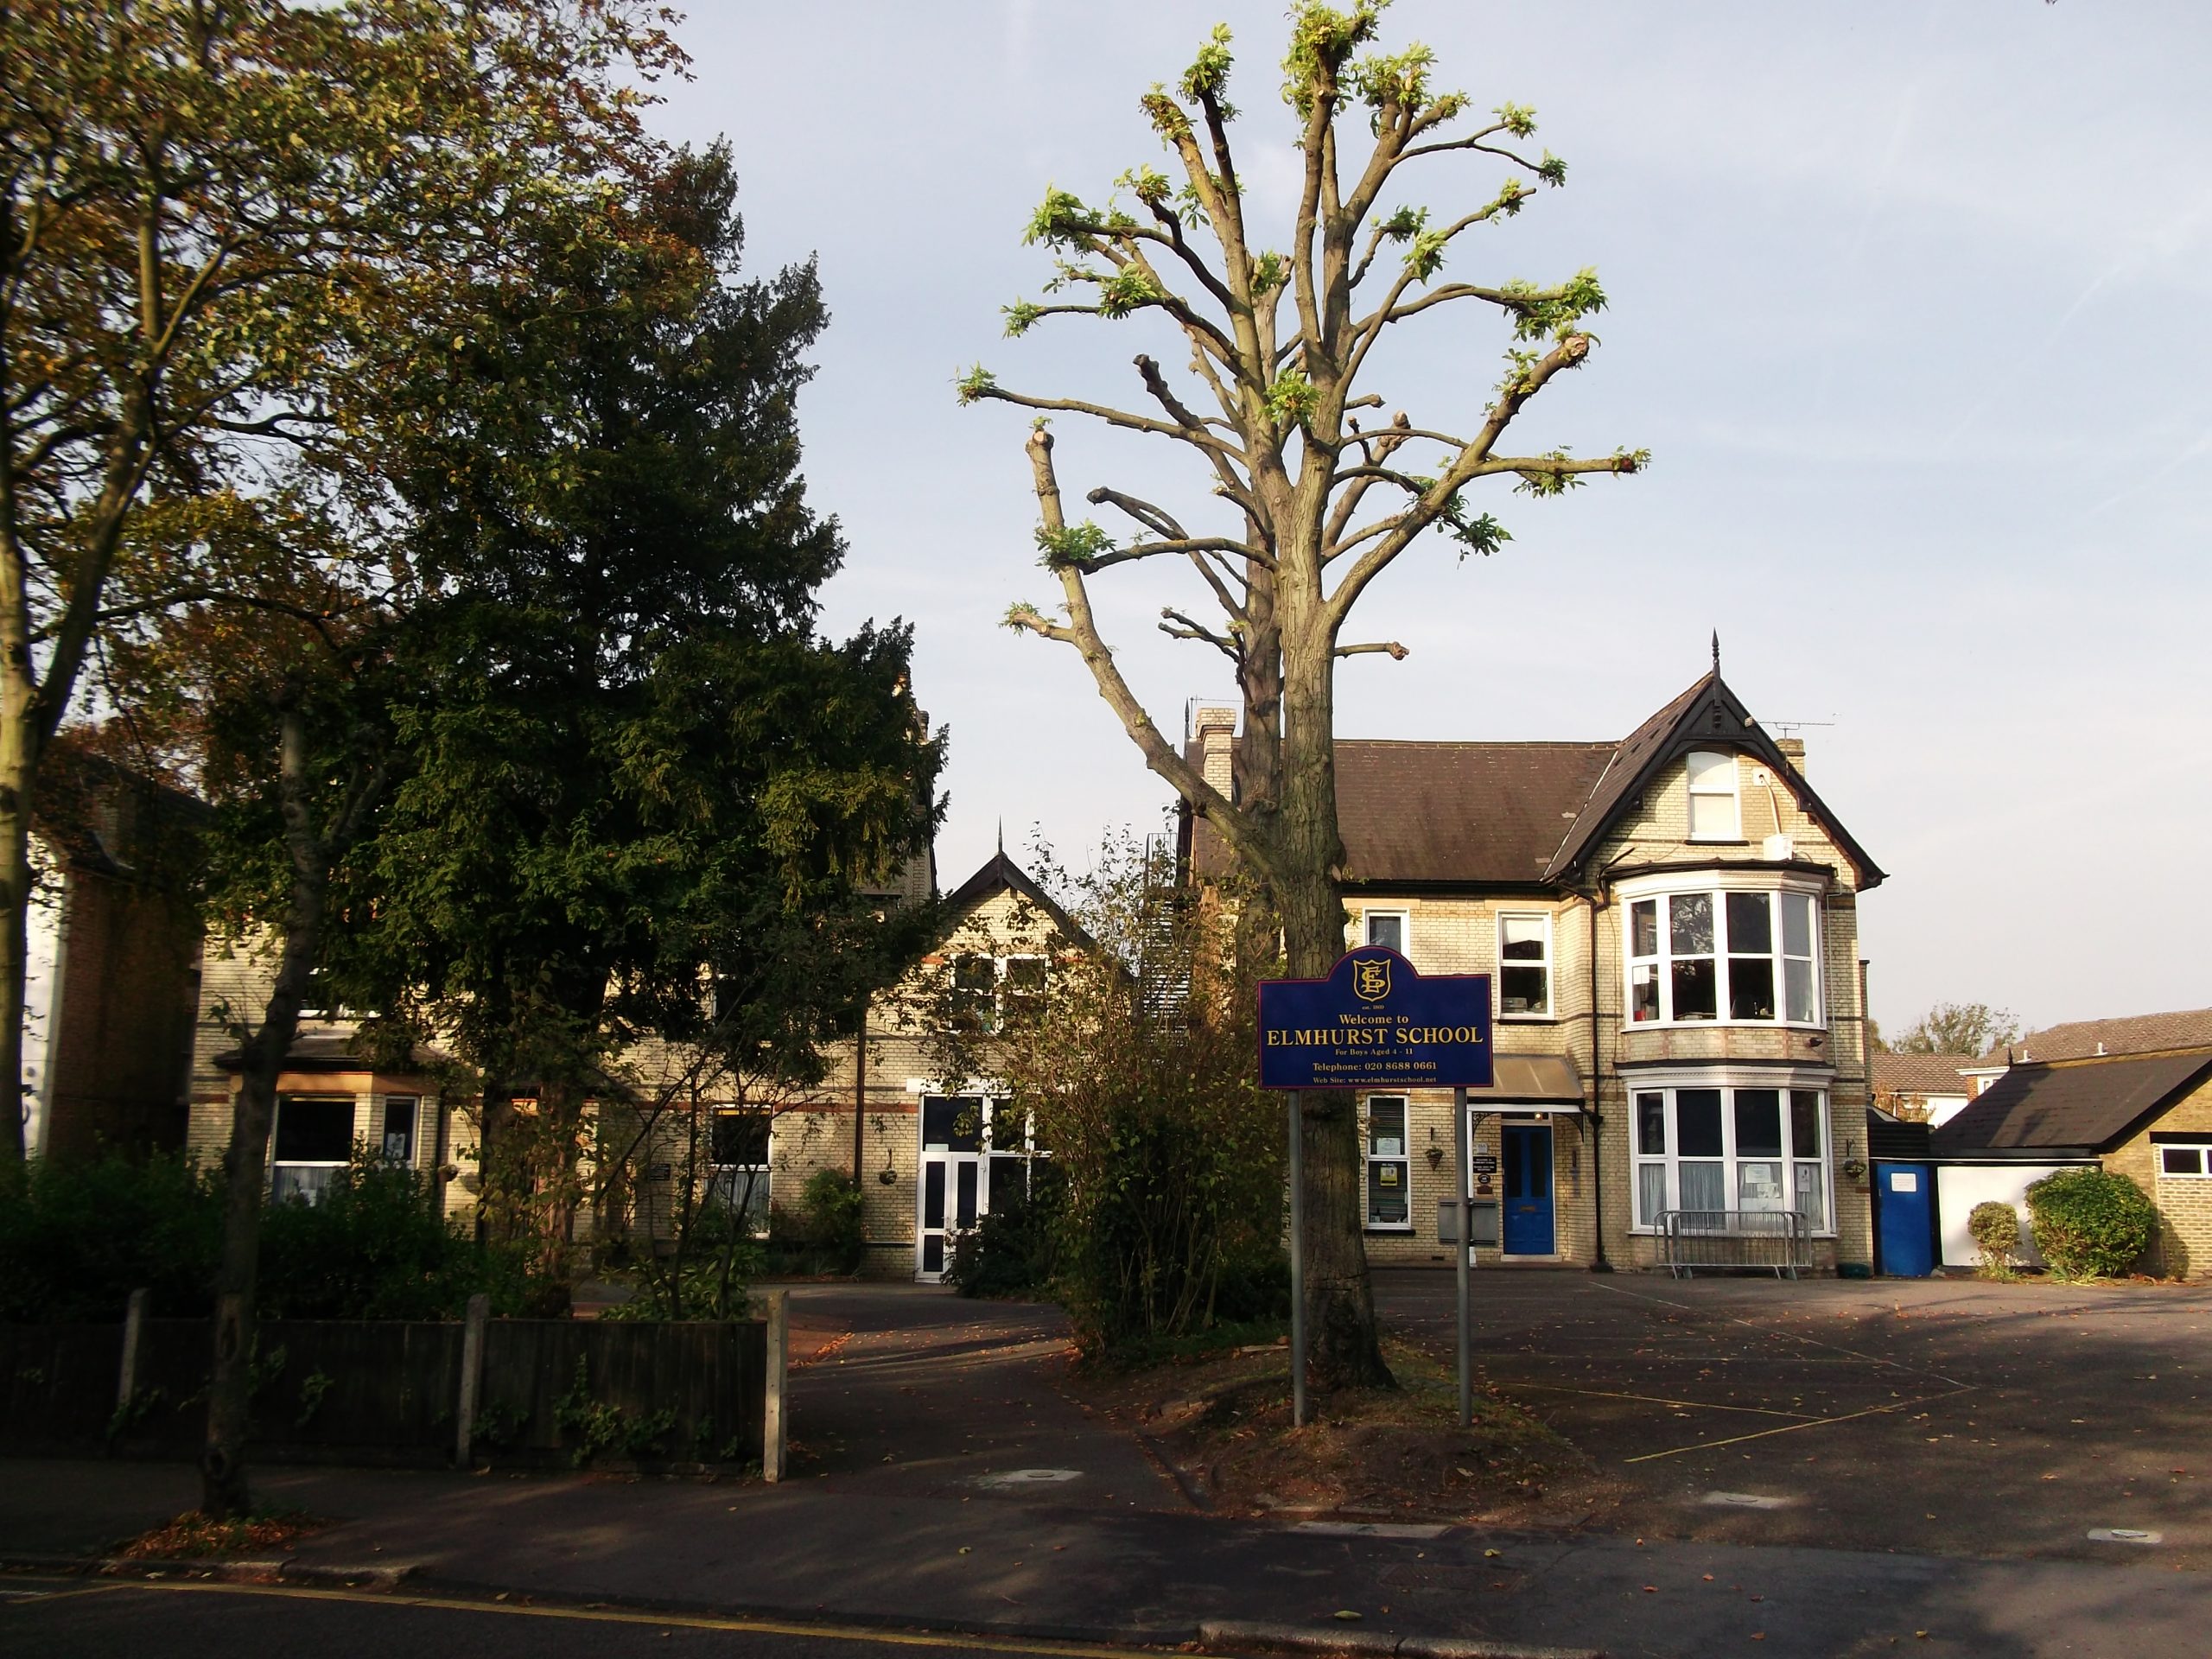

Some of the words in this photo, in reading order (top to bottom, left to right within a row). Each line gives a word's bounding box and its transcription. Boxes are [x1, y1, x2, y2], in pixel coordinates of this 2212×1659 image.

[1338, 1014, 1392, 1024] Welcome
[1396, 1014, 1408, 1024] to
[1267, 1029, 1388, 1045] ELMHURST
[1395, 1027, 1484, 1044] SCHOOL
[1350, 1048, 1368, 1057] Boys
[1370, 1048, 1390, 1057] Aged
[1313, 1063, 1362, 1072] Telephone:
[1364, 1062, 1382, 1071] 020
[1385, 1062, 1410, 1071] 8688
[1413, 1061, 1437, 1070] 0661
[1348, 1076, 1437, 1084] www.elmhurstschool.net
